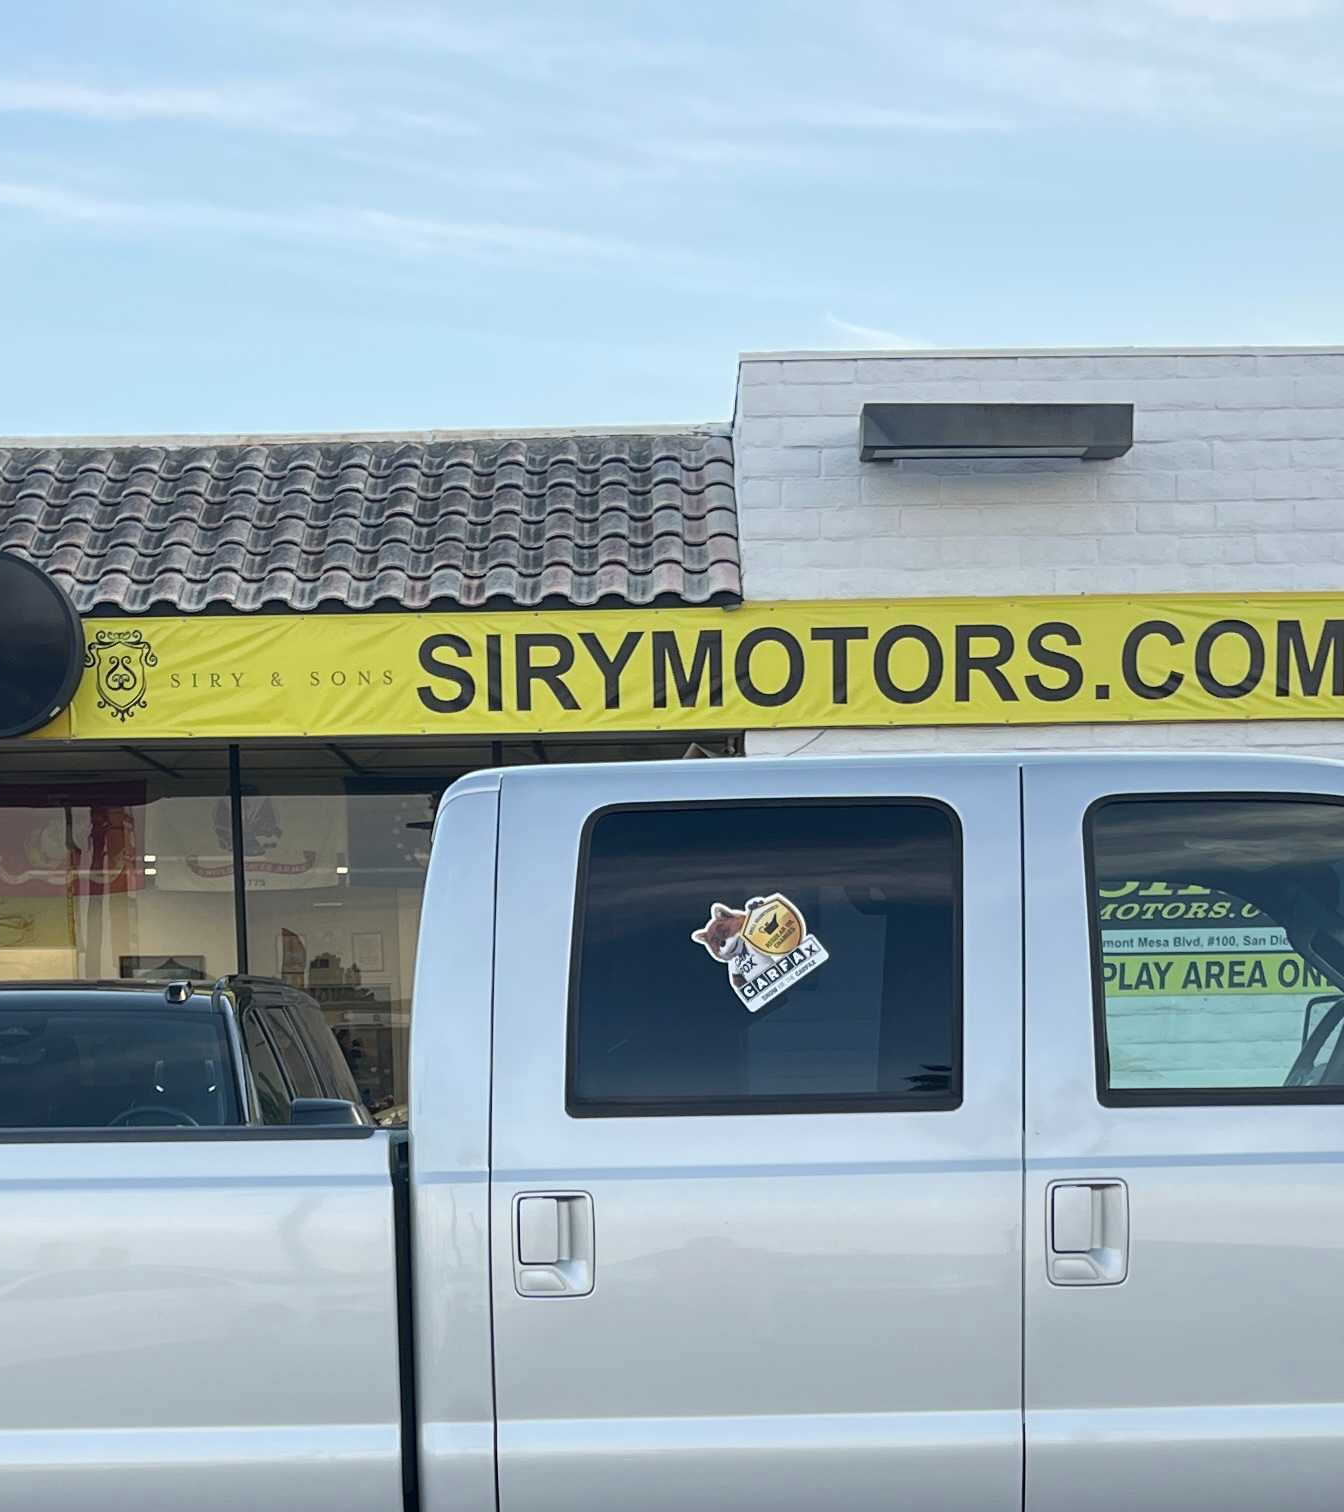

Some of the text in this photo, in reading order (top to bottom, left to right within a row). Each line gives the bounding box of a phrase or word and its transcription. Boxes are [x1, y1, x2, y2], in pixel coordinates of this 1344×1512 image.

[170, 670, 393, 688] SIRY & SONS
[1138, 937, 1169, 948] Mesa
[1243, 935, 1267, 947] San
[742, 943, 817, 999] CARFAX
[1102, 961, 1173, 990] PLAY
[1181, 960, 1268, 989] AREA
